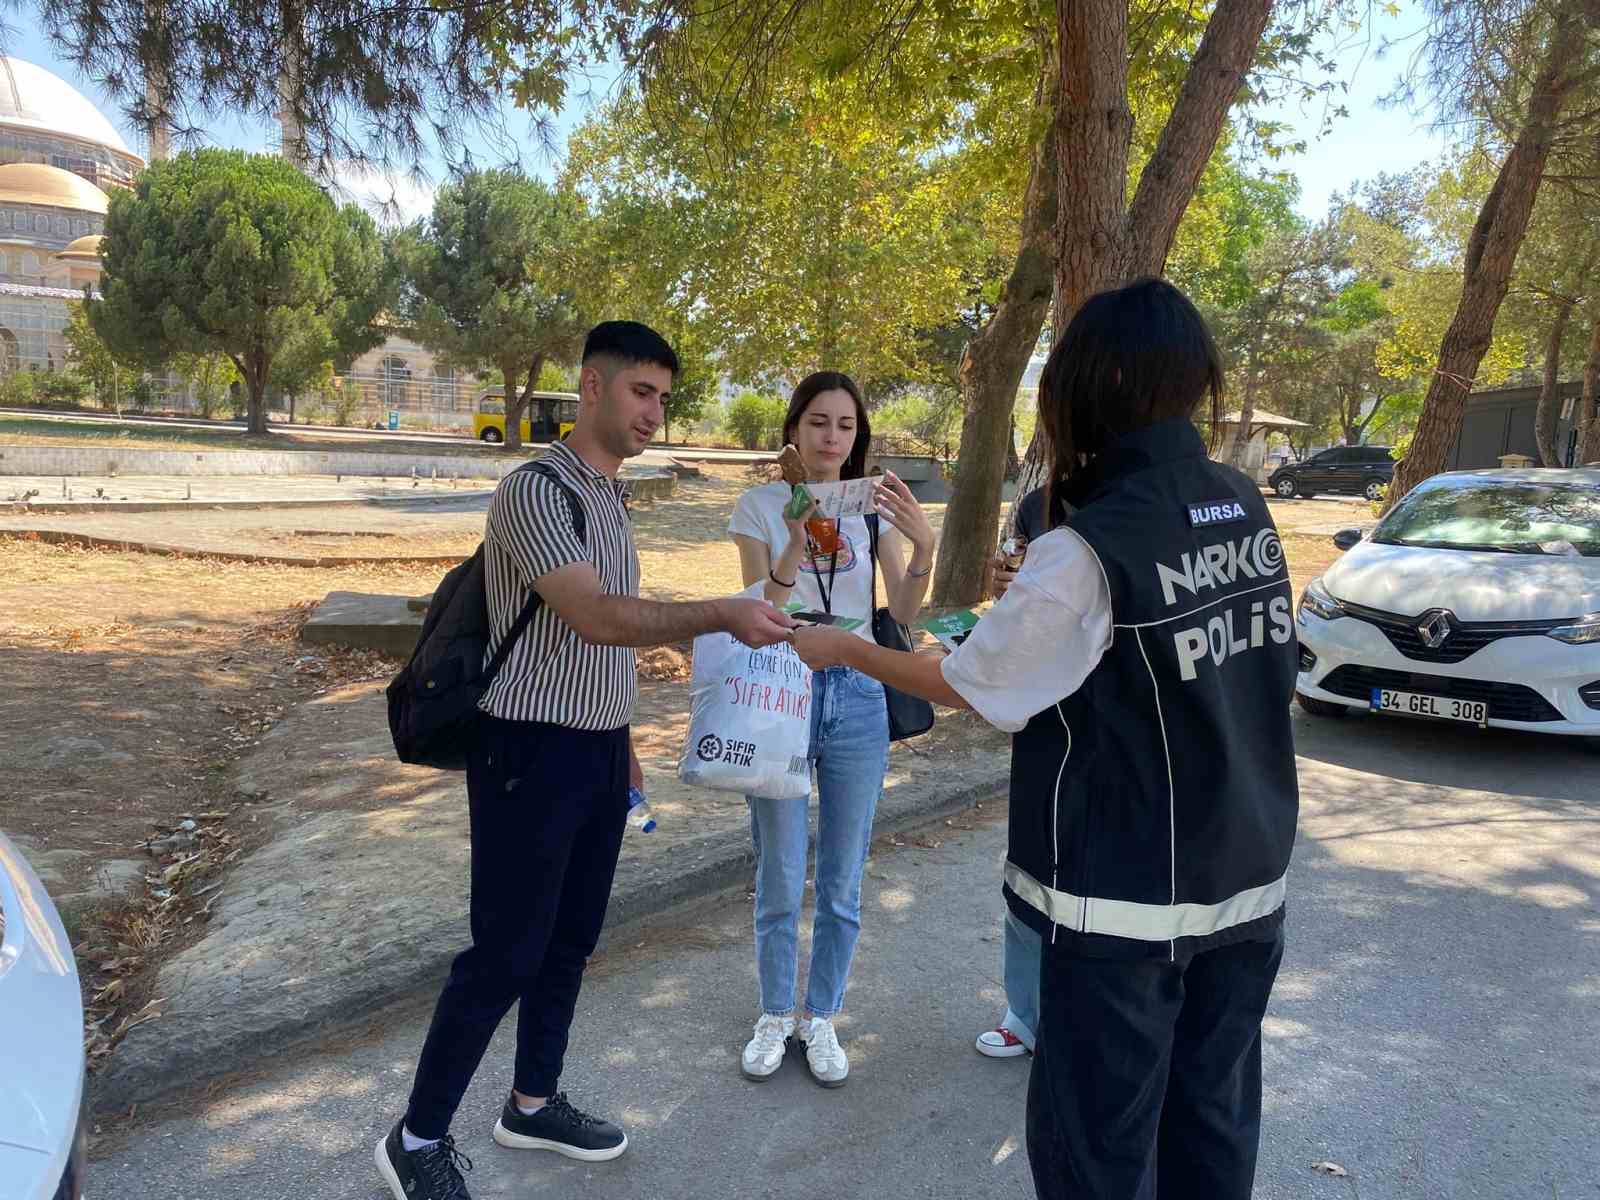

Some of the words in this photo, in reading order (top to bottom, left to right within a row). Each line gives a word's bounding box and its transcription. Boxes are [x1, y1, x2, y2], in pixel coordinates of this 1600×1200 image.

[1190, 503, 1245, 523] BURSA
[1382, 691, 1400, 709] 34
[1409, 695, 1440, 715] GEL
[1451, 701, 1484, 721] 308
[726, 739, 756, 755] SIFIR
[722, 751, 754, 767] ATIK
